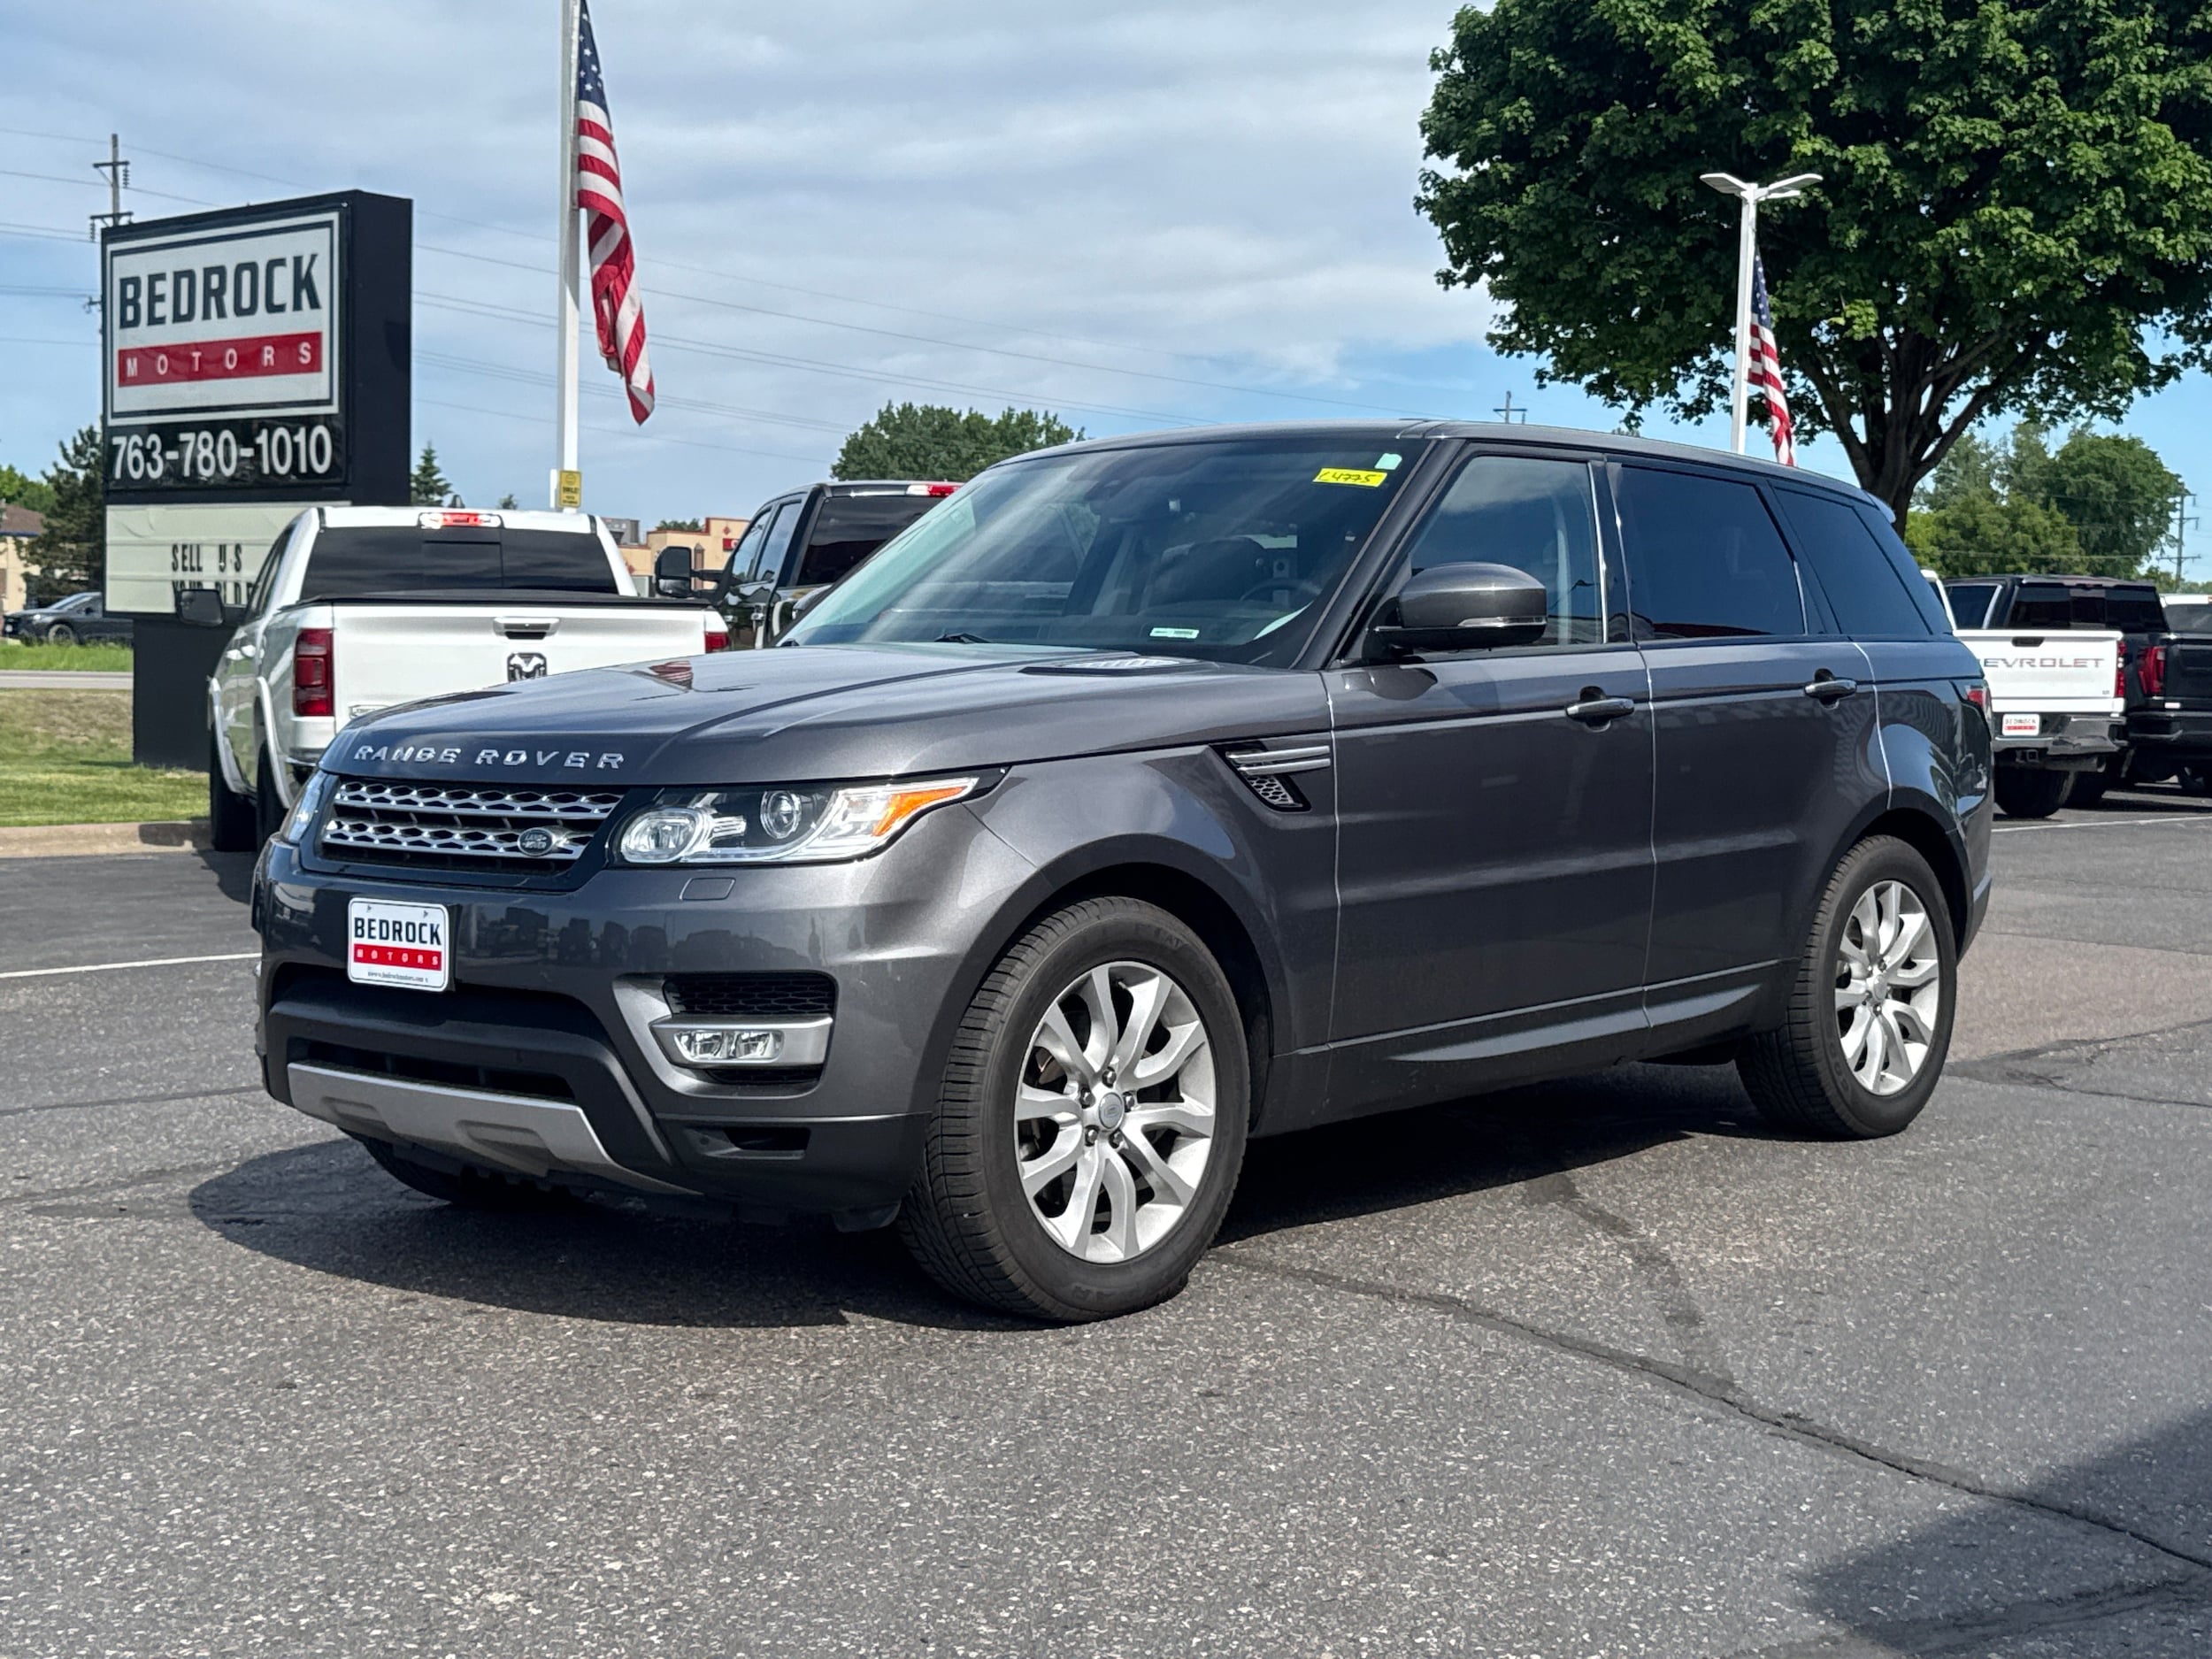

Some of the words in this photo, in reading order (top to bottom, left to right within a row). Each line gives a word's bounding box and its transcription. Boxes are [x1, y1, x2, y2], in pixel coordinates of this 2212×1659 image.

[119, 253, 322, 330] BEDROCK
[127, 342, 311, 377] MOTORS
[111, 425, 333, 480] 763-780-1010
[172, 543, 203, 572] SELL
[1983, 657, 2105, 668] EVROLET
[354, 745, 461, 764] RANGE
[474, 749, 625, 770] ROVER
[354, 917, 442, 946] BEDROCK
[357, 949, 438, 966] MOTORS
